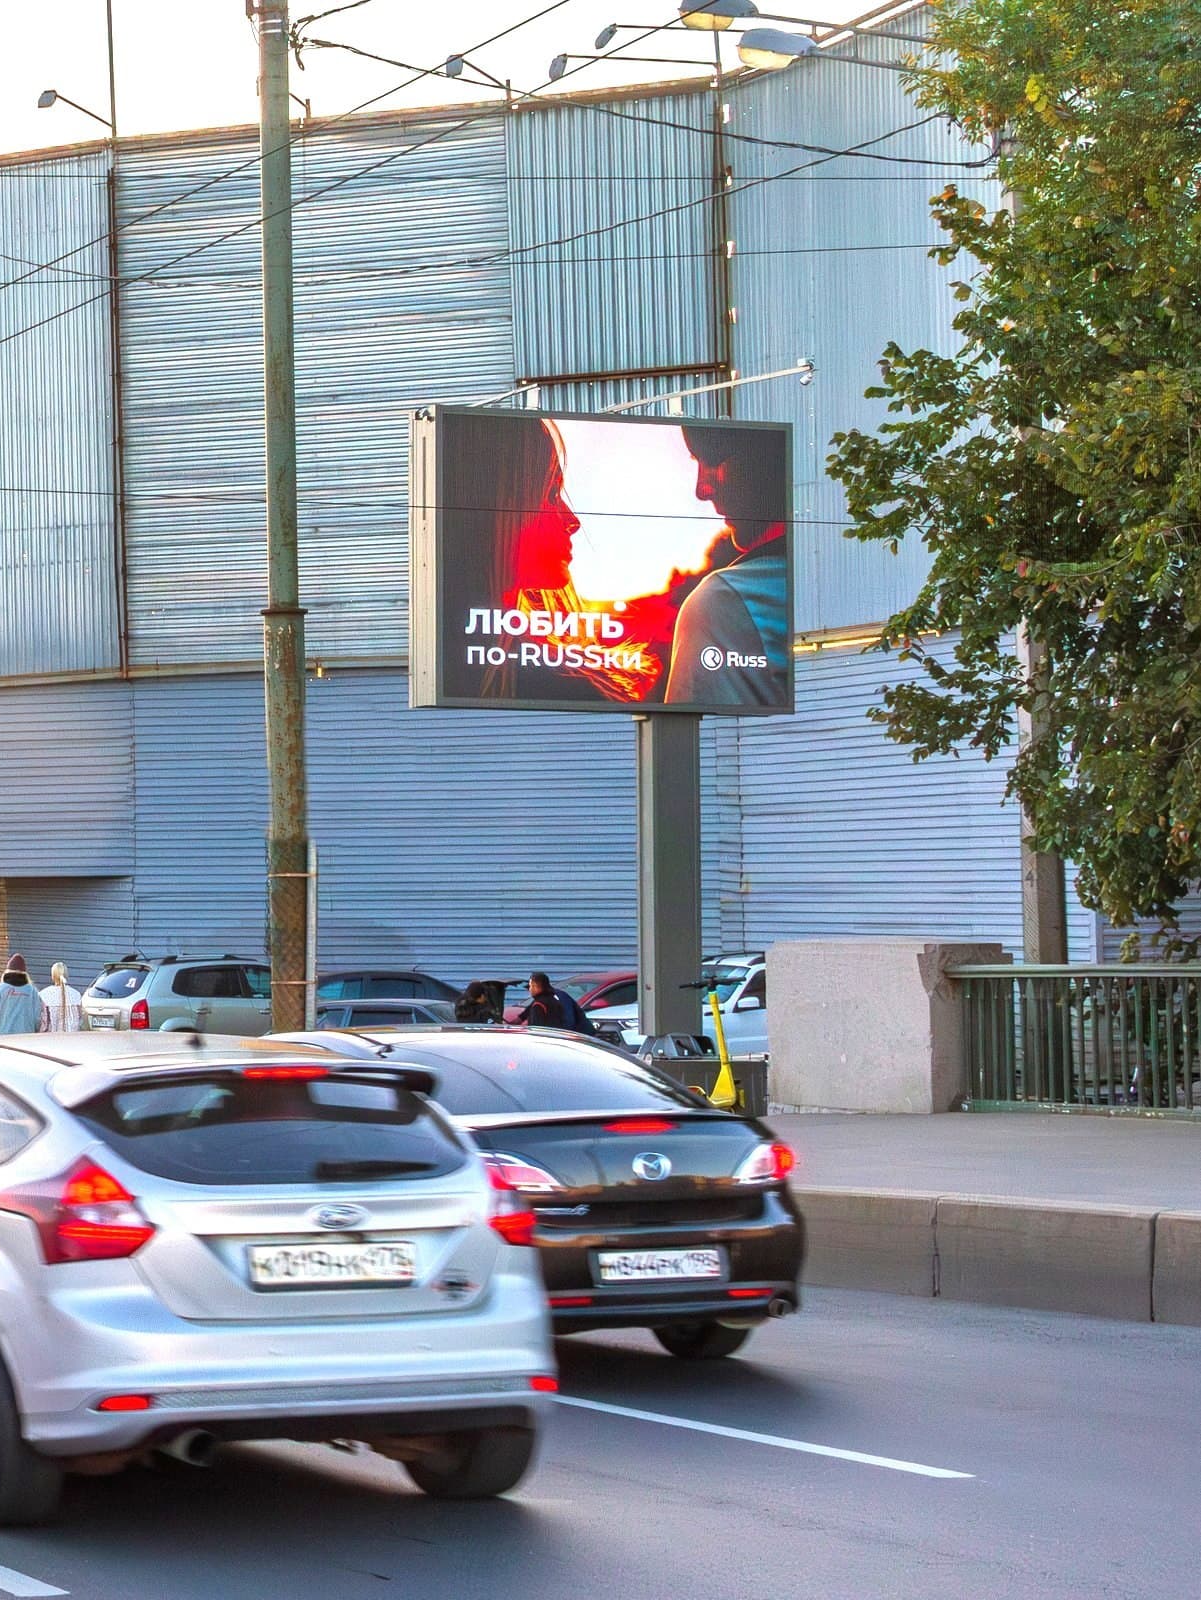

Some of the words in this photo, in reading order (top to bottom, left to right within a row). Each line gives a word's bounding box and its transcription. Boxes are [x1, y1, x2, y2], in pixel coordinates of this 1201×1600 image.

[465, 608, 624, 639] ЛЮБИТЬ
[467, 643, 641, 669] по-RUSSки
[726, 651, 768, 668] Russ
